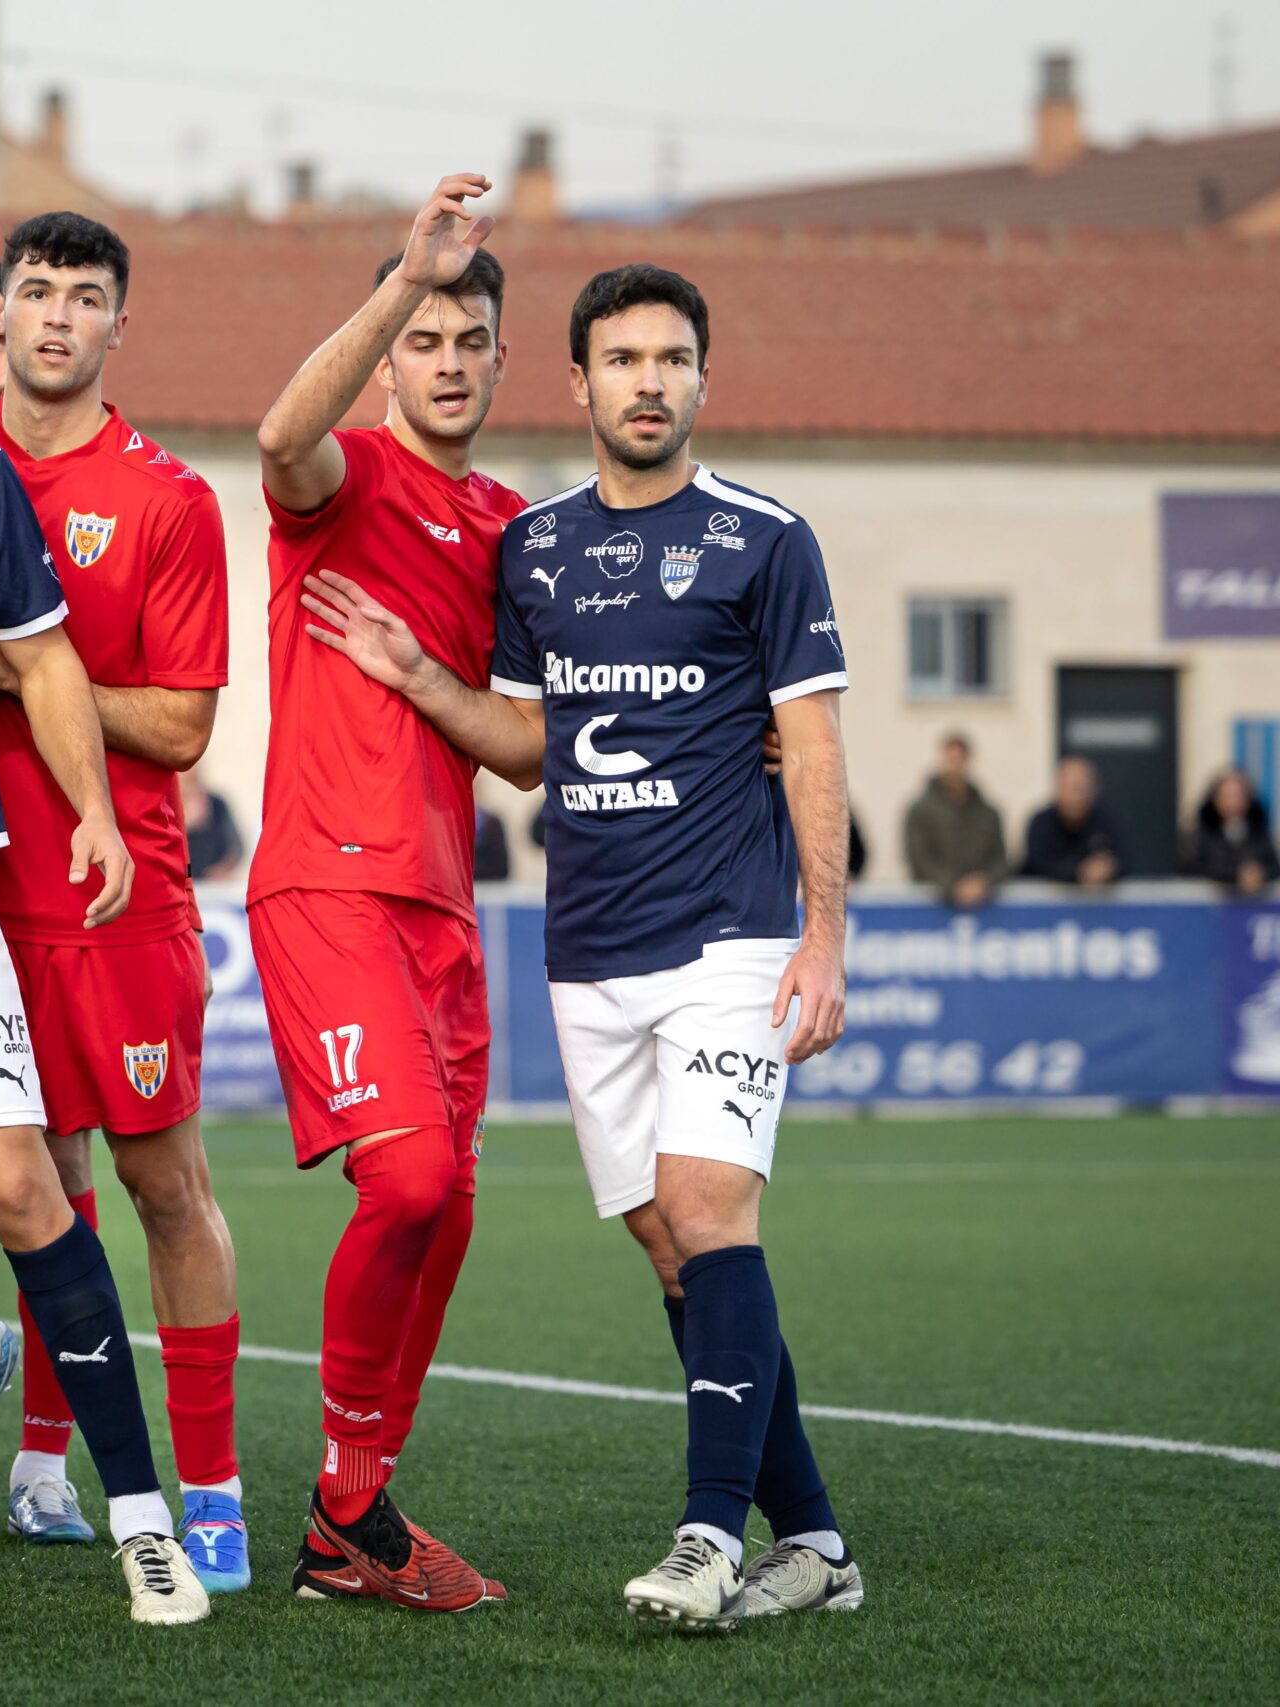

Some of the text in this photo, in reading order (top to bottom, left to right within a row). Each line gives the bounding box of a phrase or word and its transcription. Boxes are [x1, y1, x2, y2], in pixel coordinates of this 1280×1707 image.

[584, 541, 640, 557] euronix
[616, 554, 636, 567] sport
[664, 563, 695, 578] UTEBO
[543, 651, 706, 701] Alcampo
[560, 779, 680, 812] CINTASA
[319, 1023, 363, 1089] 17
[684, 1048, 780, 1087] ACYF
[327, 1083, 380, 1113] LEGEA
[737, 1081, 776, 1102] GROUP
